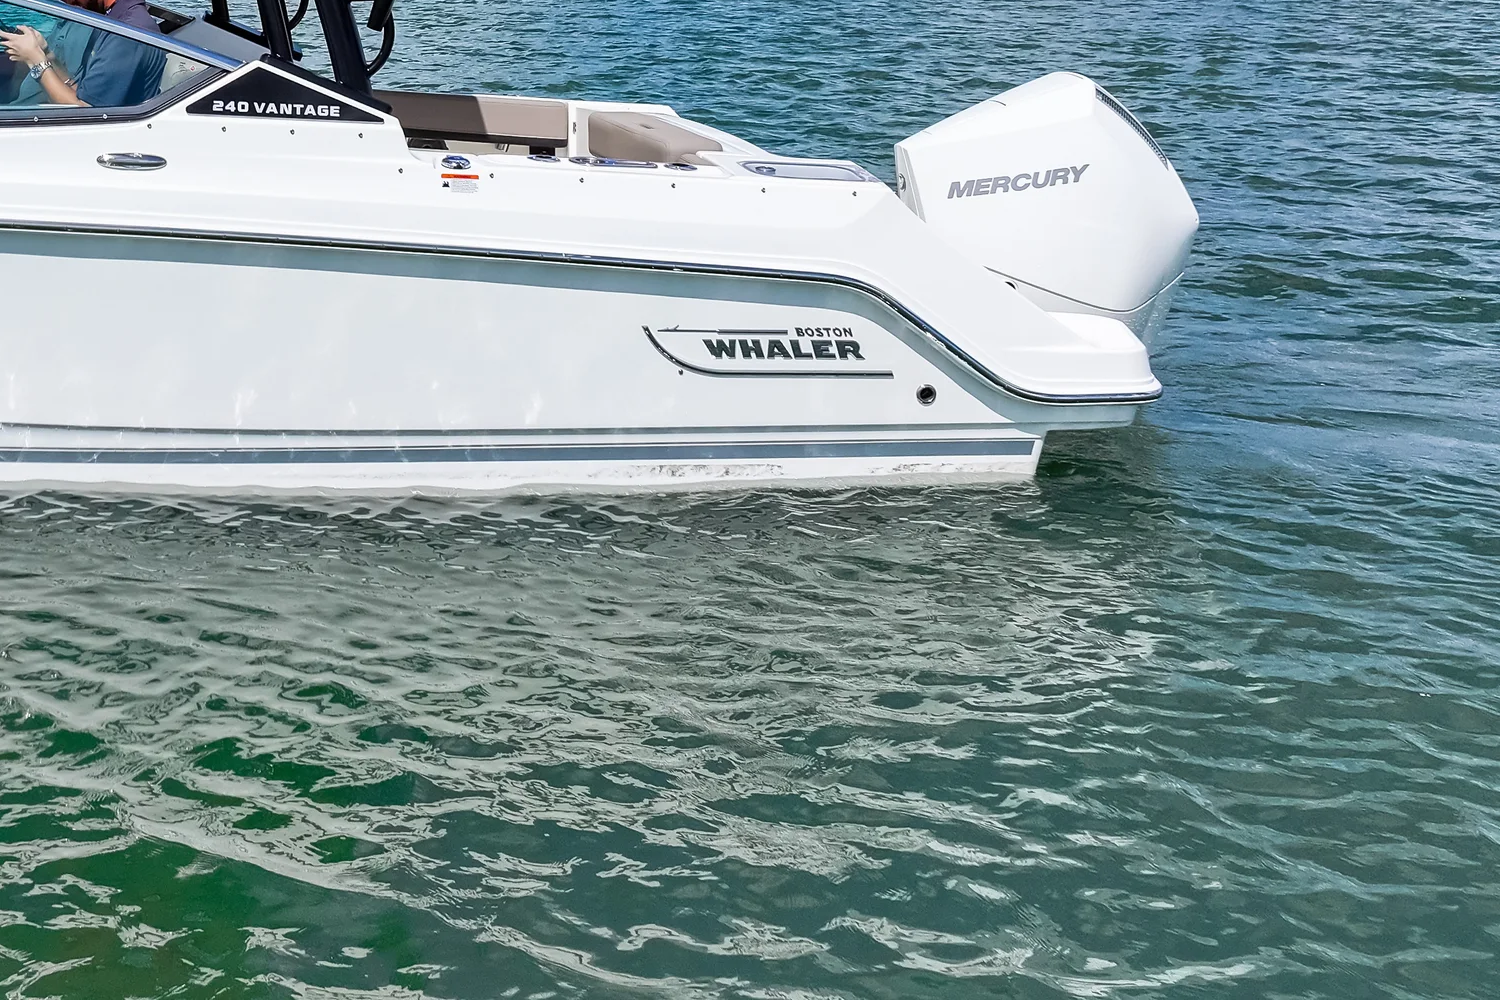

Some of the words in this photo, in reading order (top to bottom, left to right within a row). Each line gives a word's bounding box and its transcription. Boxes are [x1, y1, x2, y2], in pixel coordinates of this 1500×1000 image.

[212, 100, 249, 113] 240
[253, 101, 341, 117] VANTAGE
[947, 163, 1091, 200] MERCURY
[795, 327, 854, 338] BOSTON
[701, 338, 866, 361] WHALER
